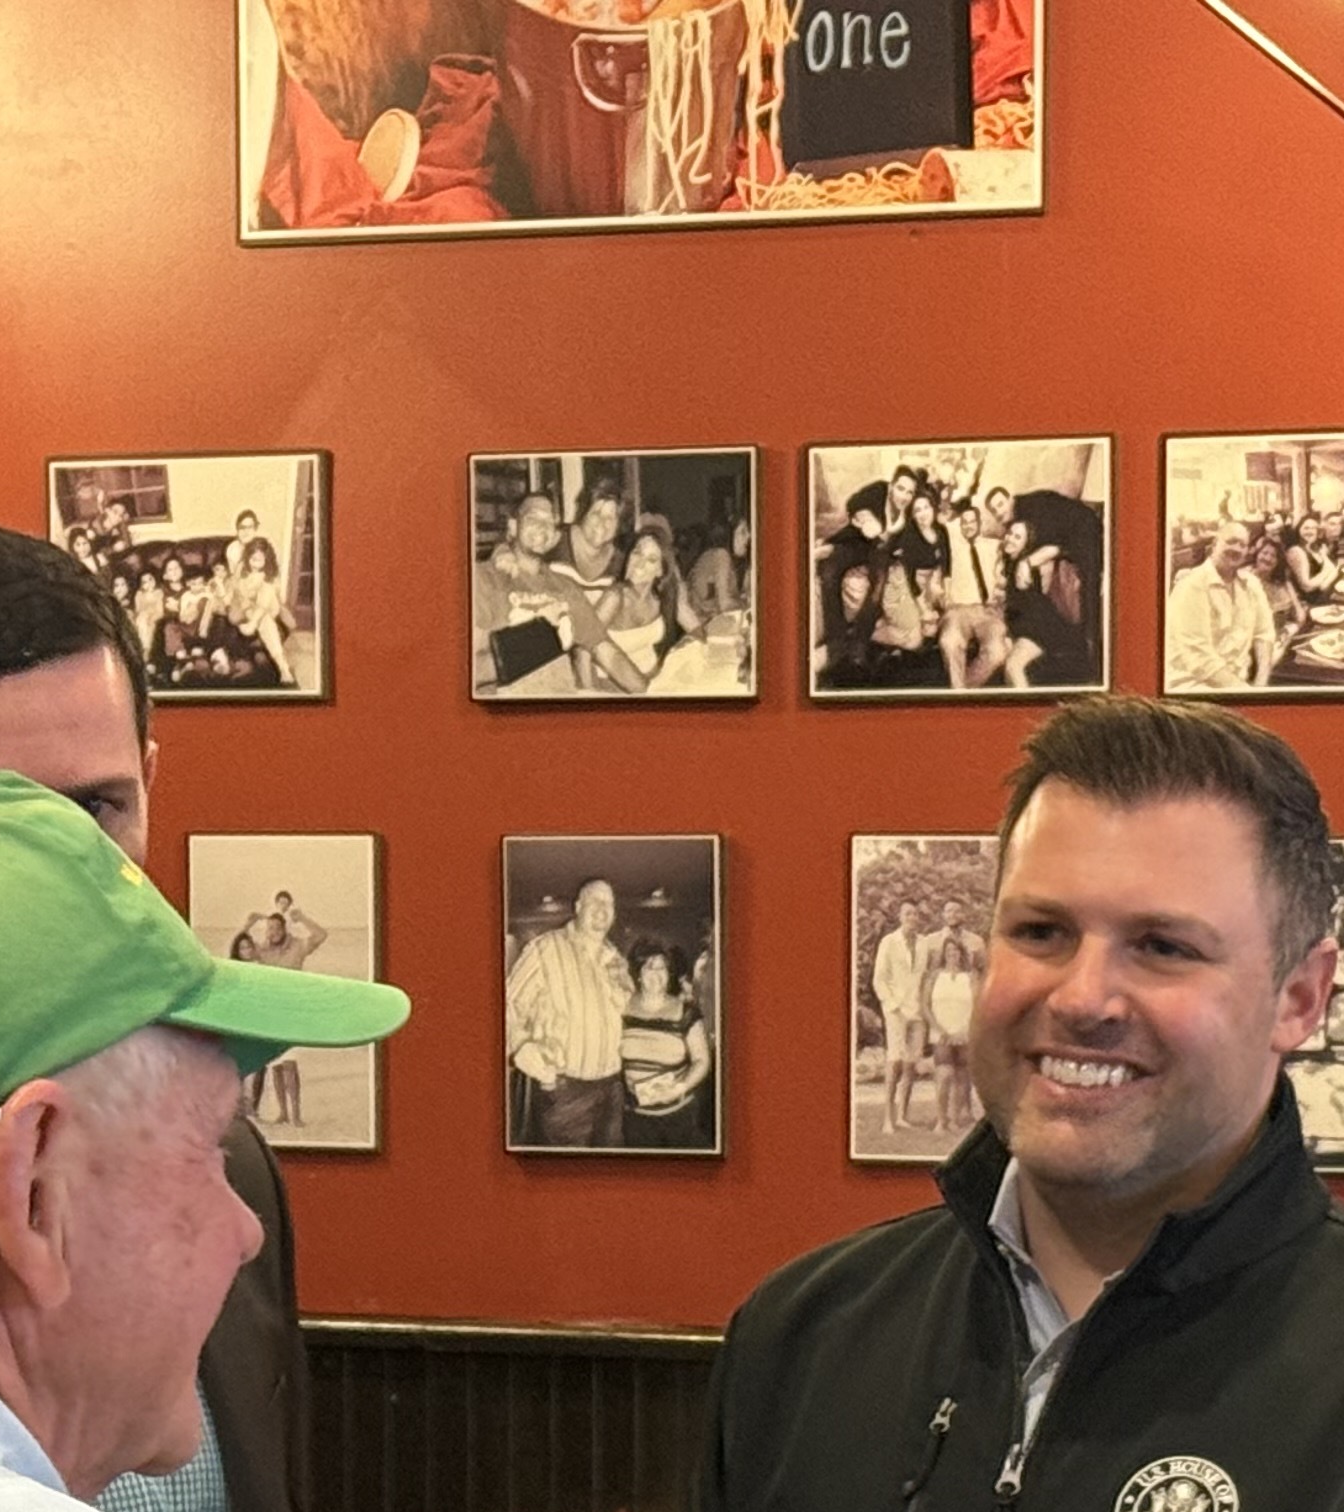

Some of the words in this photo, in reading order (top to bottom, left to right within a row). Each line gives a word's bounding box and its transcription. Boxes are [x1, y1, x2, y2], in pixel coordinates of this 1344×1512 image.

[807, 10, 910, 72] one
[1169, 1460, 1223, 1488] HOUSE
[1216, 1484, 1234, 1504] OF
